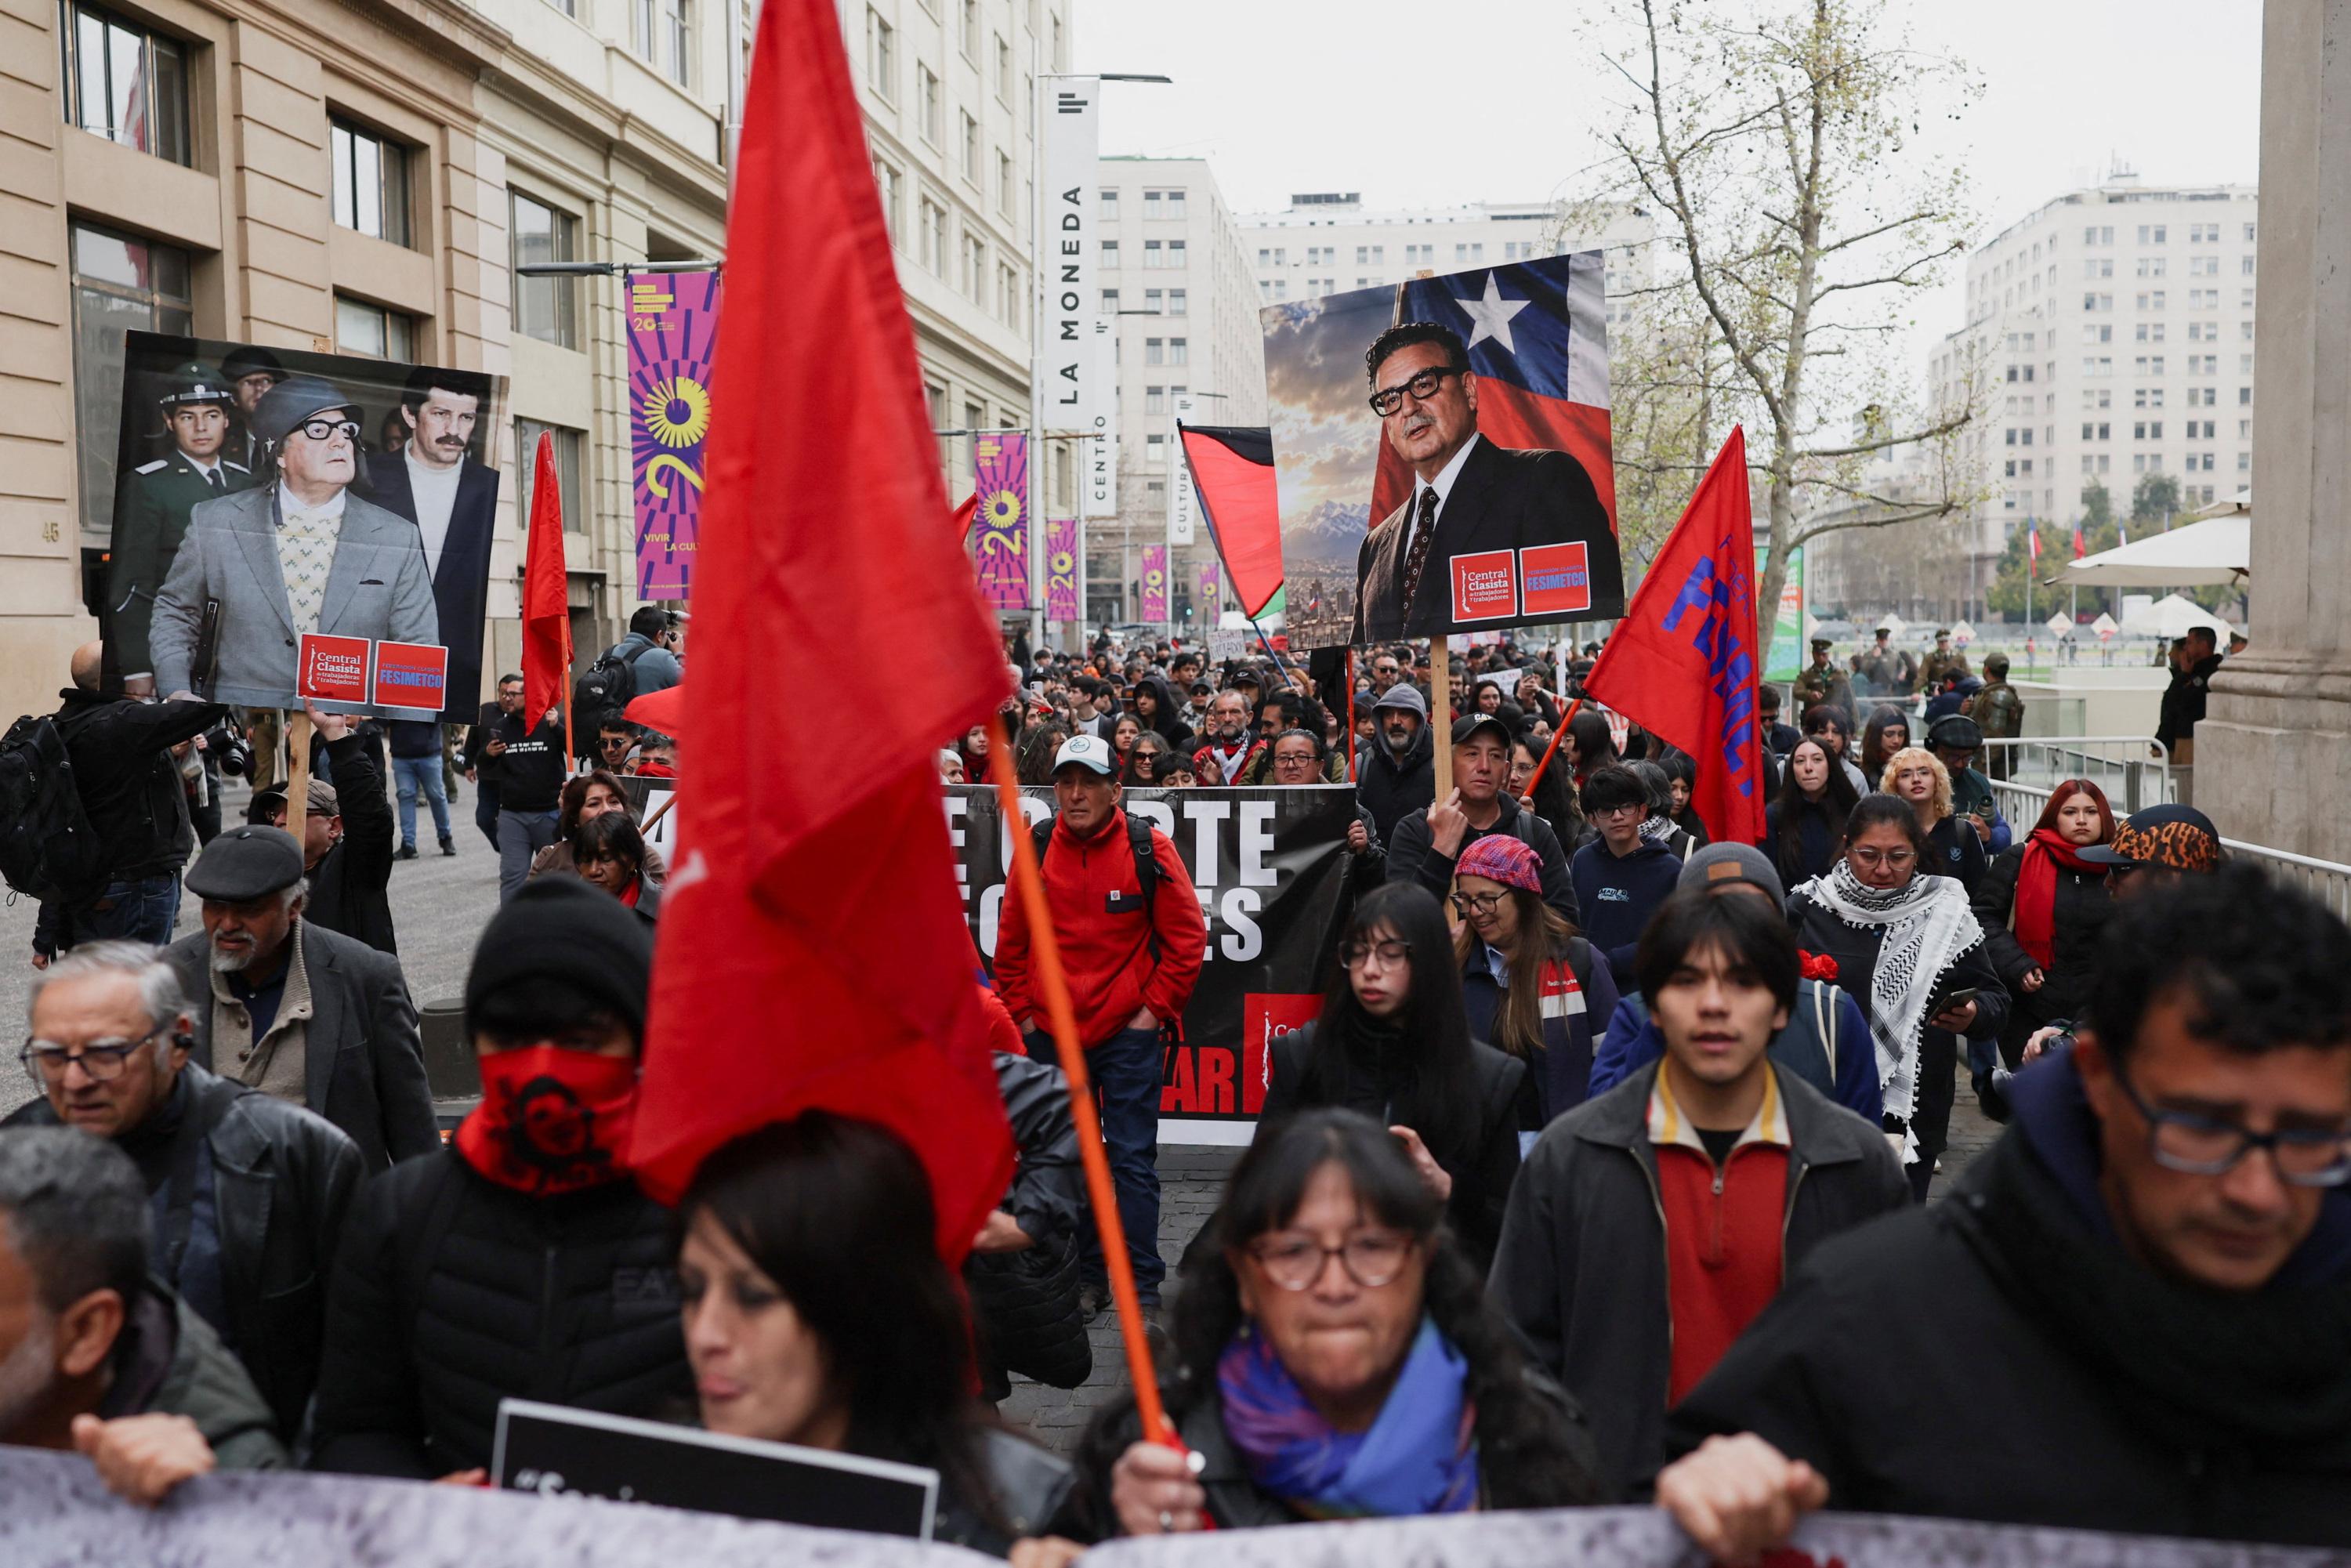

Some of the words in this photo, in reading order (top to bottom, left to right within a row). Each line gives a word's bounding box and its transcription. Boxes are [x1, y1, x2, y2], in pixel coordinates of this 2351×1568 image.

[1060, 186, 1081, 340] MONEDA
[1060, 363, 1078, 404] LA
[1094, 416, 1107, 500] CENTRO
[42, 522, 59, 542] 45
[644, 534, 670, 542] VIVIR
[664, 542, 677, 552] LA
[1468, 568, 1507, 581] Central
[1527, 571, 1585, 591] FESIMETCO
[1468, 578, 1509, 591] Clasista
[1473, 594, 1509, 603] trabajadores
[317, 652, 360, 664] Central
[317, 662, 360, 675] Clasista
[320, 676, 360, 686] trabajadores
[321, 672, 360, 681] trabajadoras
[380, 669, 442, 688] FESIMETCO
